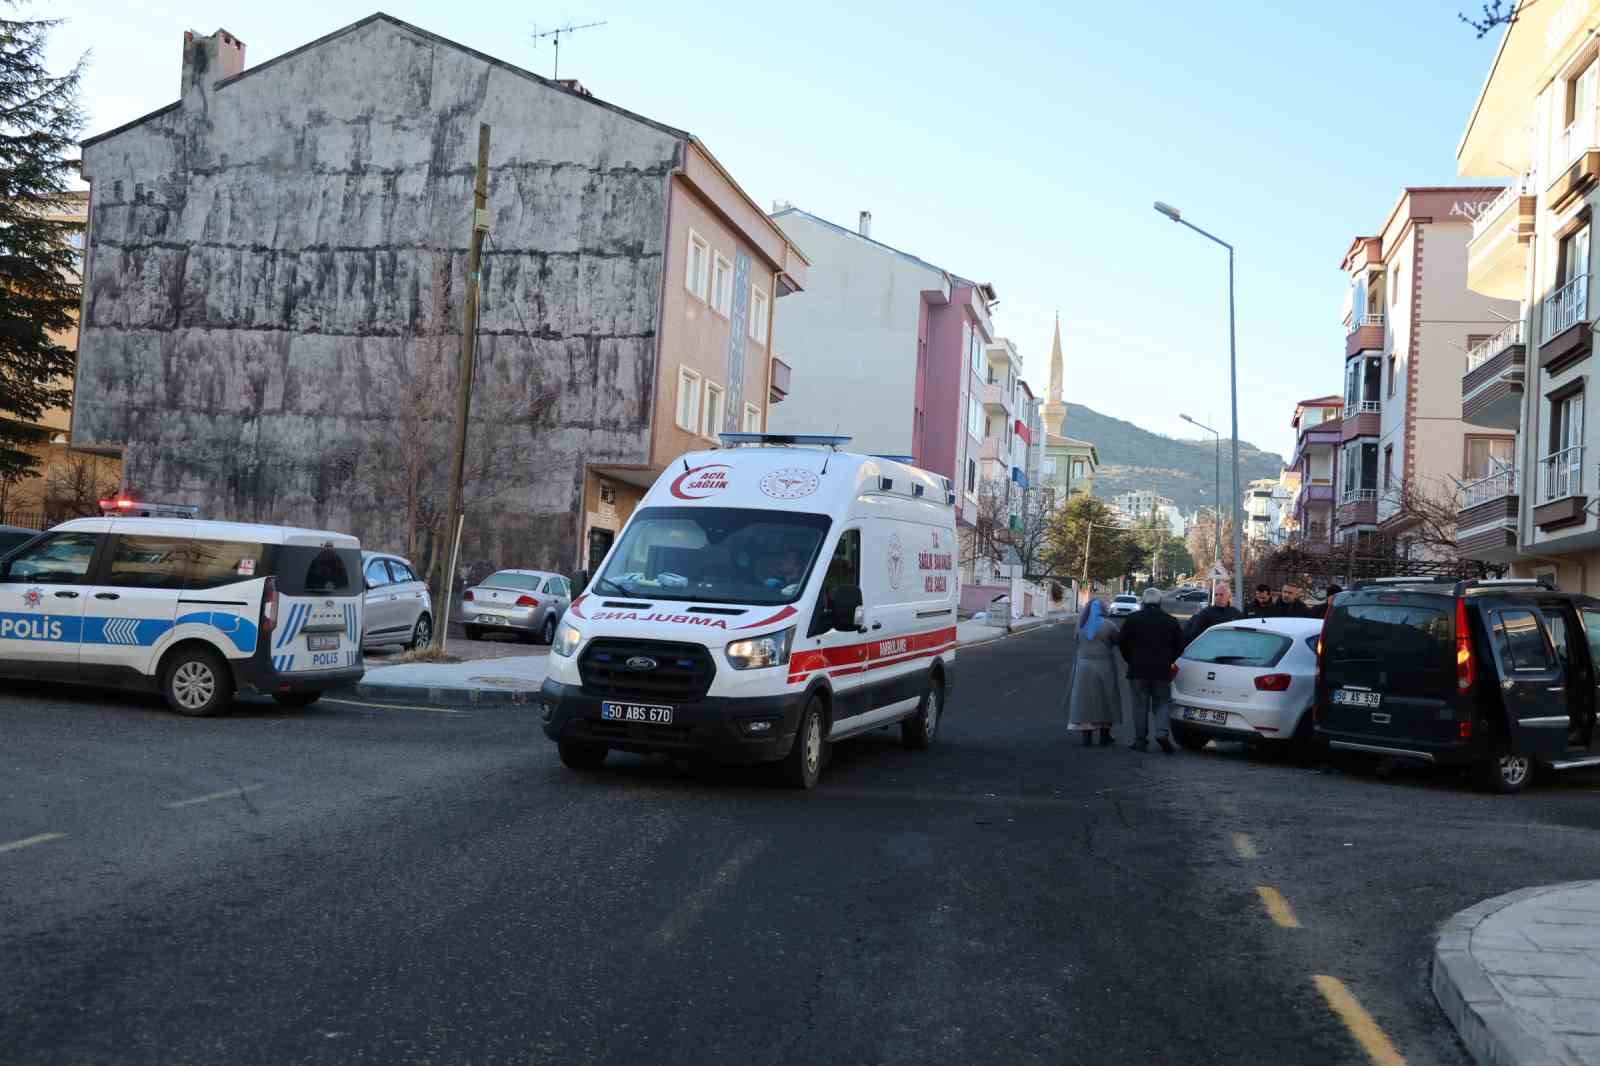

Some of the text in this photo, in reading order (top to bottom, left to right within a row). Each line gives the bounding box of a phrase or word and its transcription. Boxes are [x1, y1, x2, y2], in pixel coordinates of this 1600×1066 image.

[1, 615, 63, 640] POLİS
[609, 704, 671, 722] 50 ABS 670
